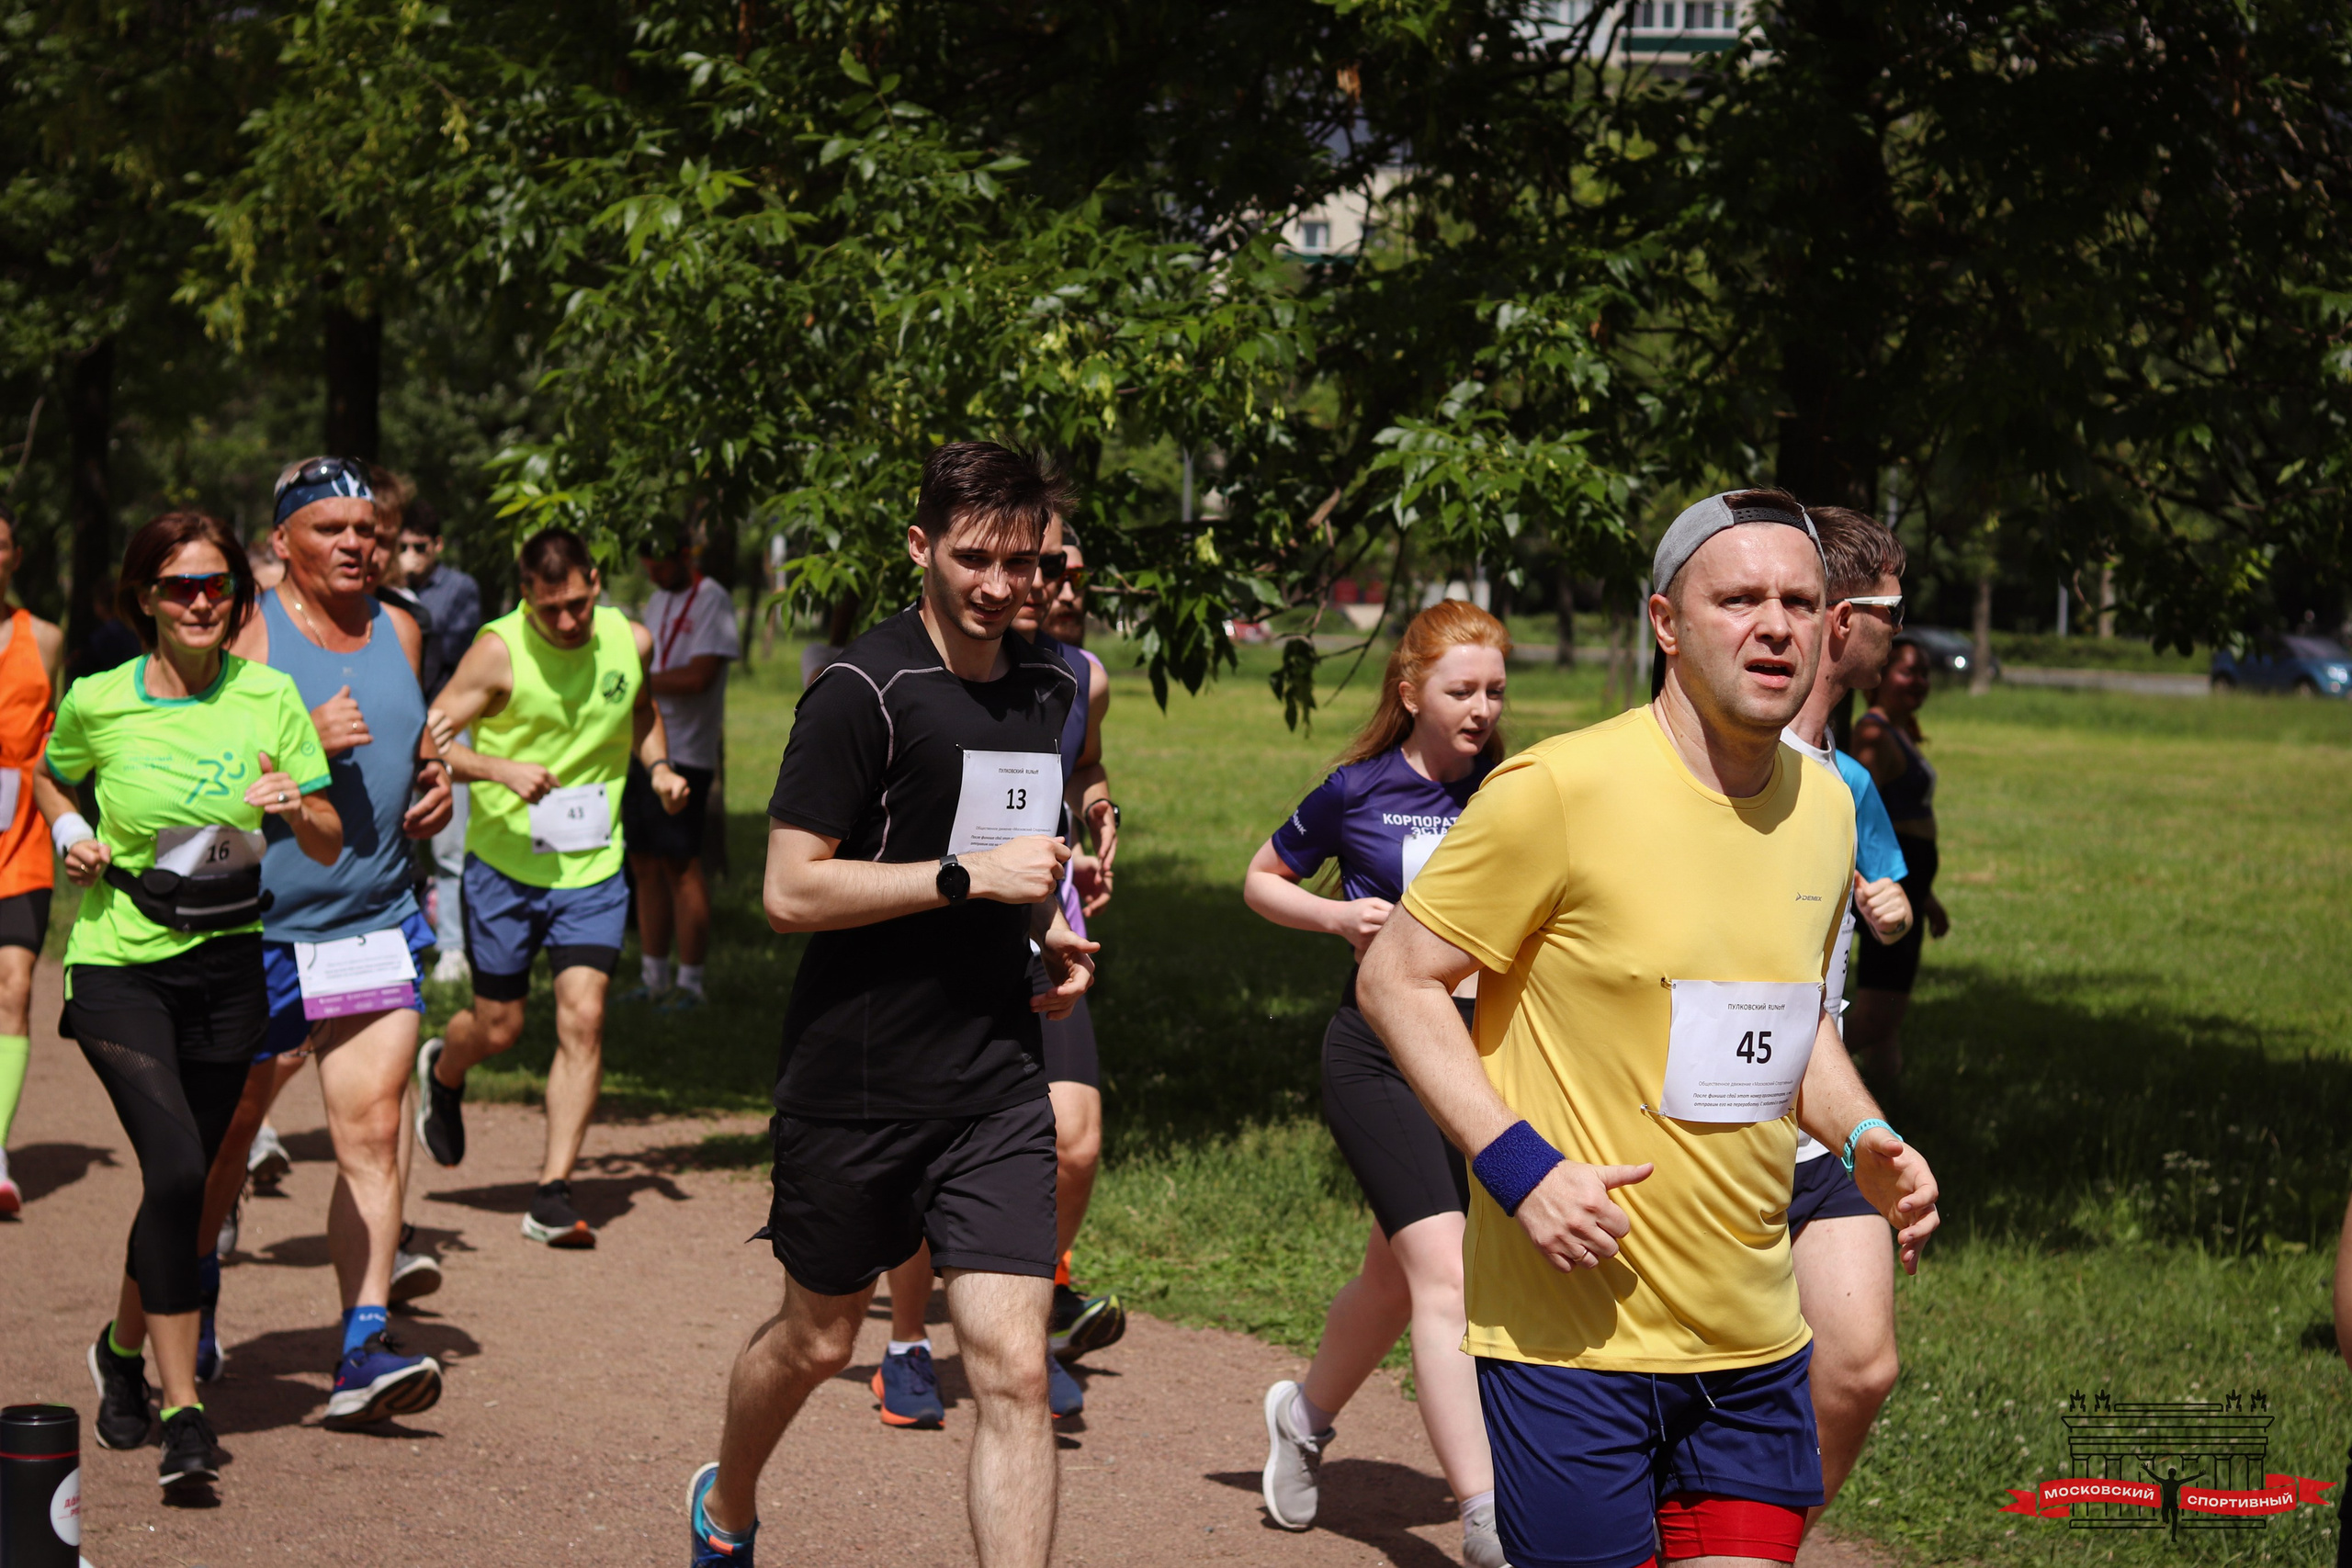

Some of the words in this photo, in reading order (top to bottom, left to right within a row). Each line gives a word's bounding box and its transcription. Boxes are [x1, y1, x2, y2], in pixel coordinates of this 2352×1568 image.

[1006, 788, 1026, 810] 13
[568, 807, 583, 819] 43
[206, 840, 230, 863] 16
[1736, 1031, 1772, 1064] 45
